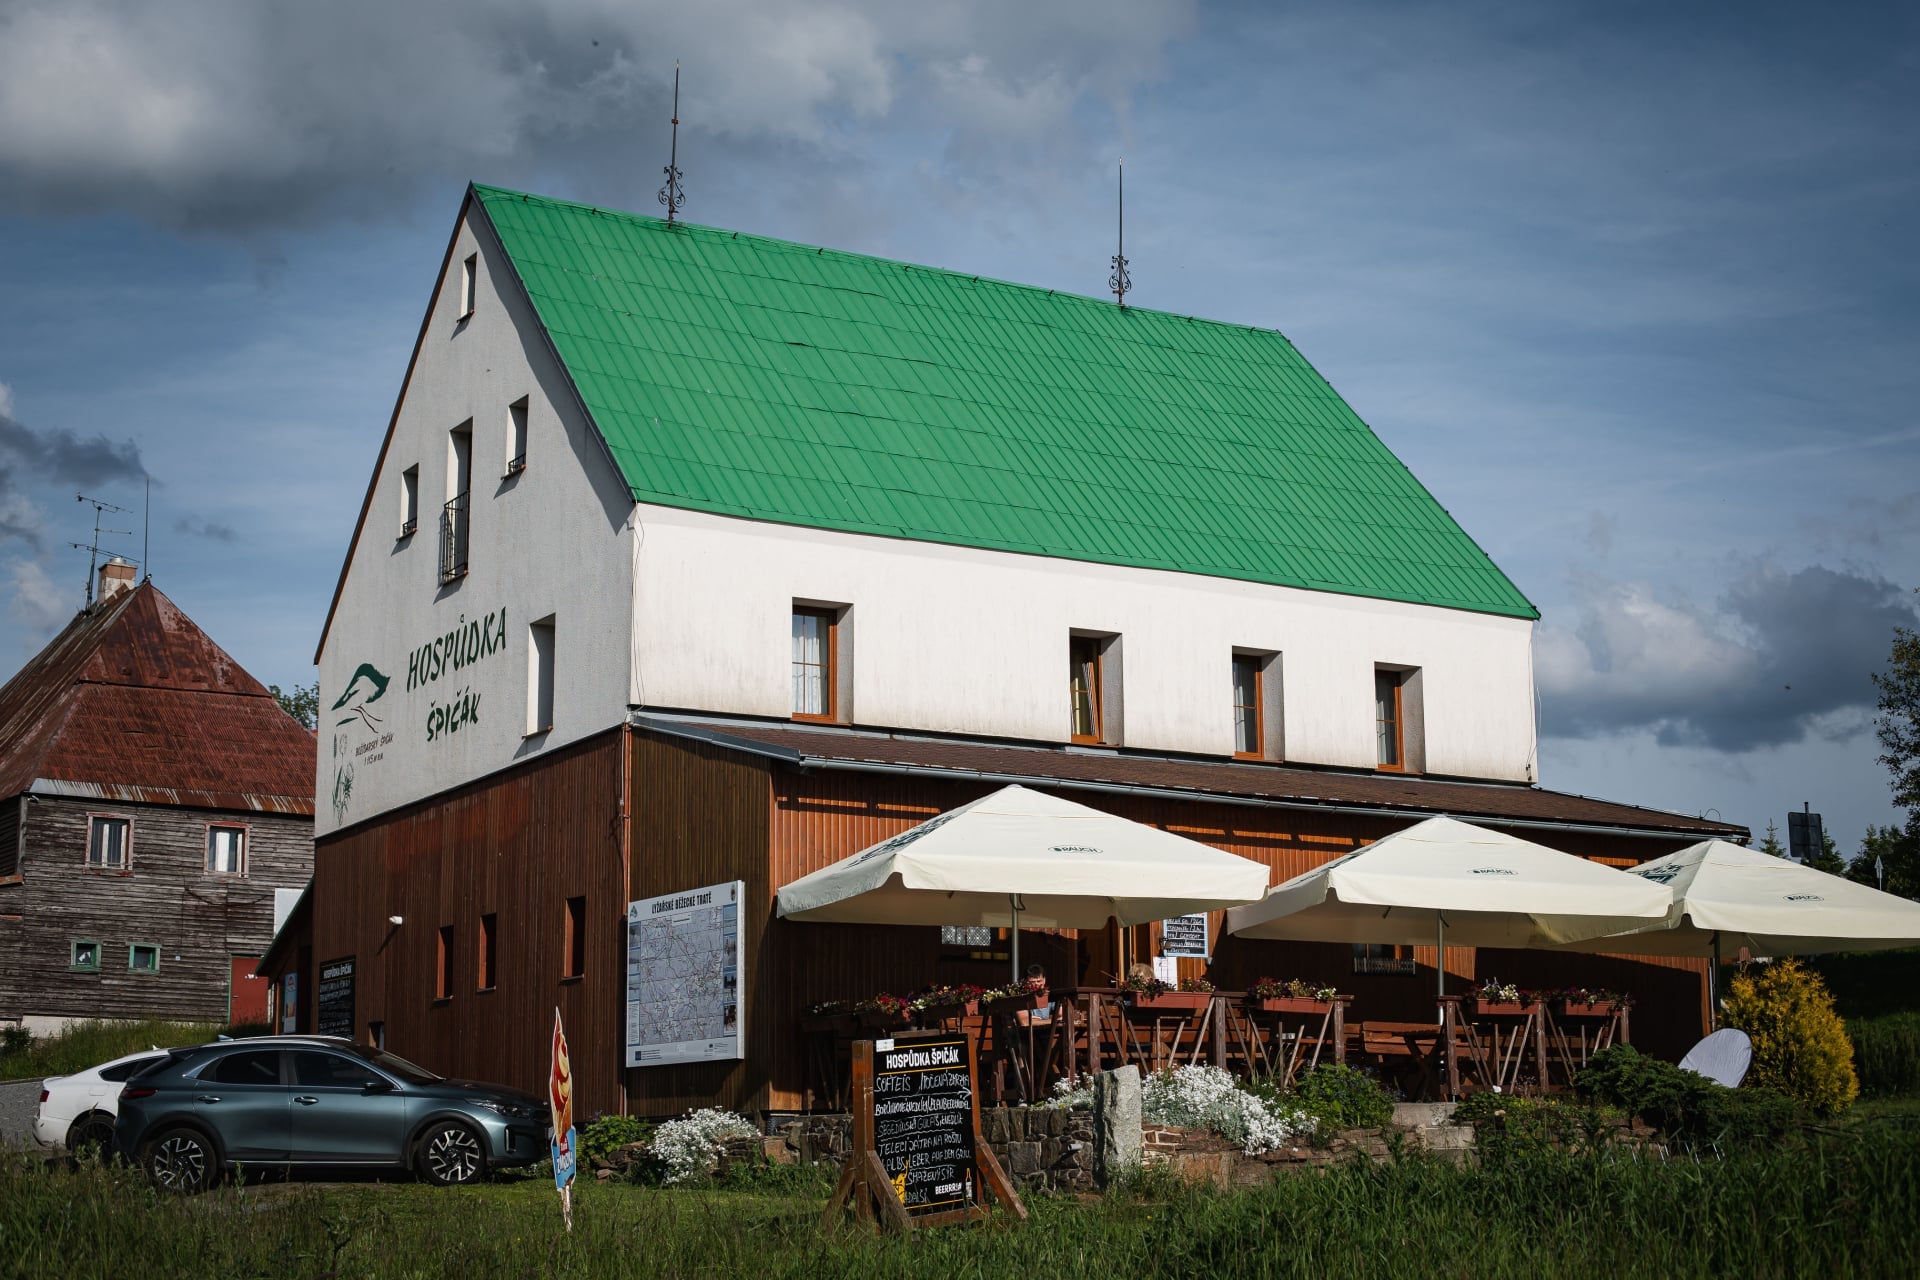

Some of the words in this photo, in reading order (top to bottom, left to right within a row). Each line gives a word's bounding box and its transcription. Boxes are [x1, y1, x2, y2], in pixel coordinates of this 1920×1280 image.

[407, 606, 506, 692] HOSPŮDKA
[427, 685, 481, 742] ŠPIČÁK
[652, 898, 674, 915] LYŽAŘSKÉ
[886, 1049, 930, 1070] HOSPŮDKA
[931, 1046, 960, 1065] ŠPIČÁK
[878, 1136, 908, 1157] TELECÍ
[933, 1136, 943, 1147] NA
[932, 1151, 944, 1162] AUF
[944, 1148, 955, 1159] DEM
